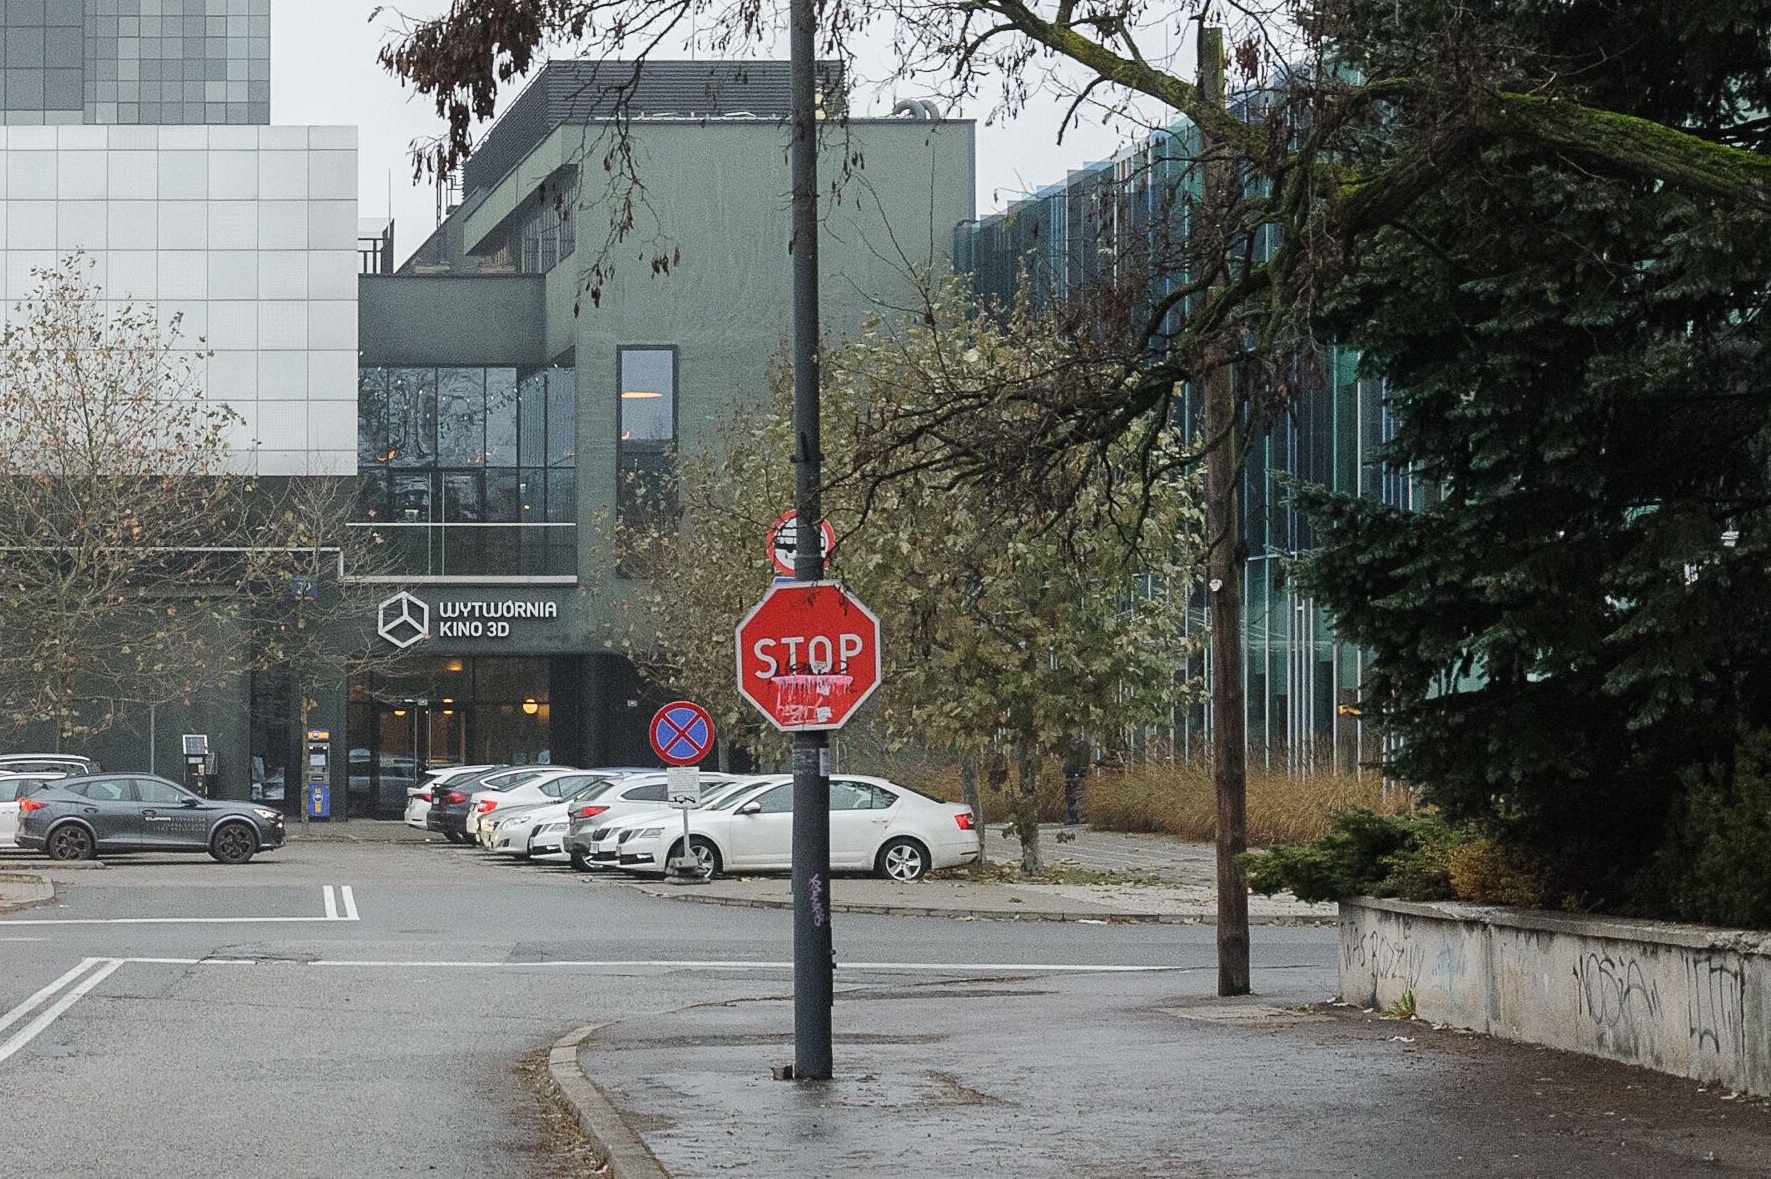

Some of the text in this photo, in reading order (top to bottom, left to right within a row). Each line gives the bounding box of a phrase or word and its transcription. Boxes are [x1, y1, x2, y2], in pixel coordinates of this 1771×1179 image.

[439, 600, 557, 618] WYTWÓRNIA
[439, 621, 509, 637] KINO 3D
[753, 633, 863, 679] STOP
